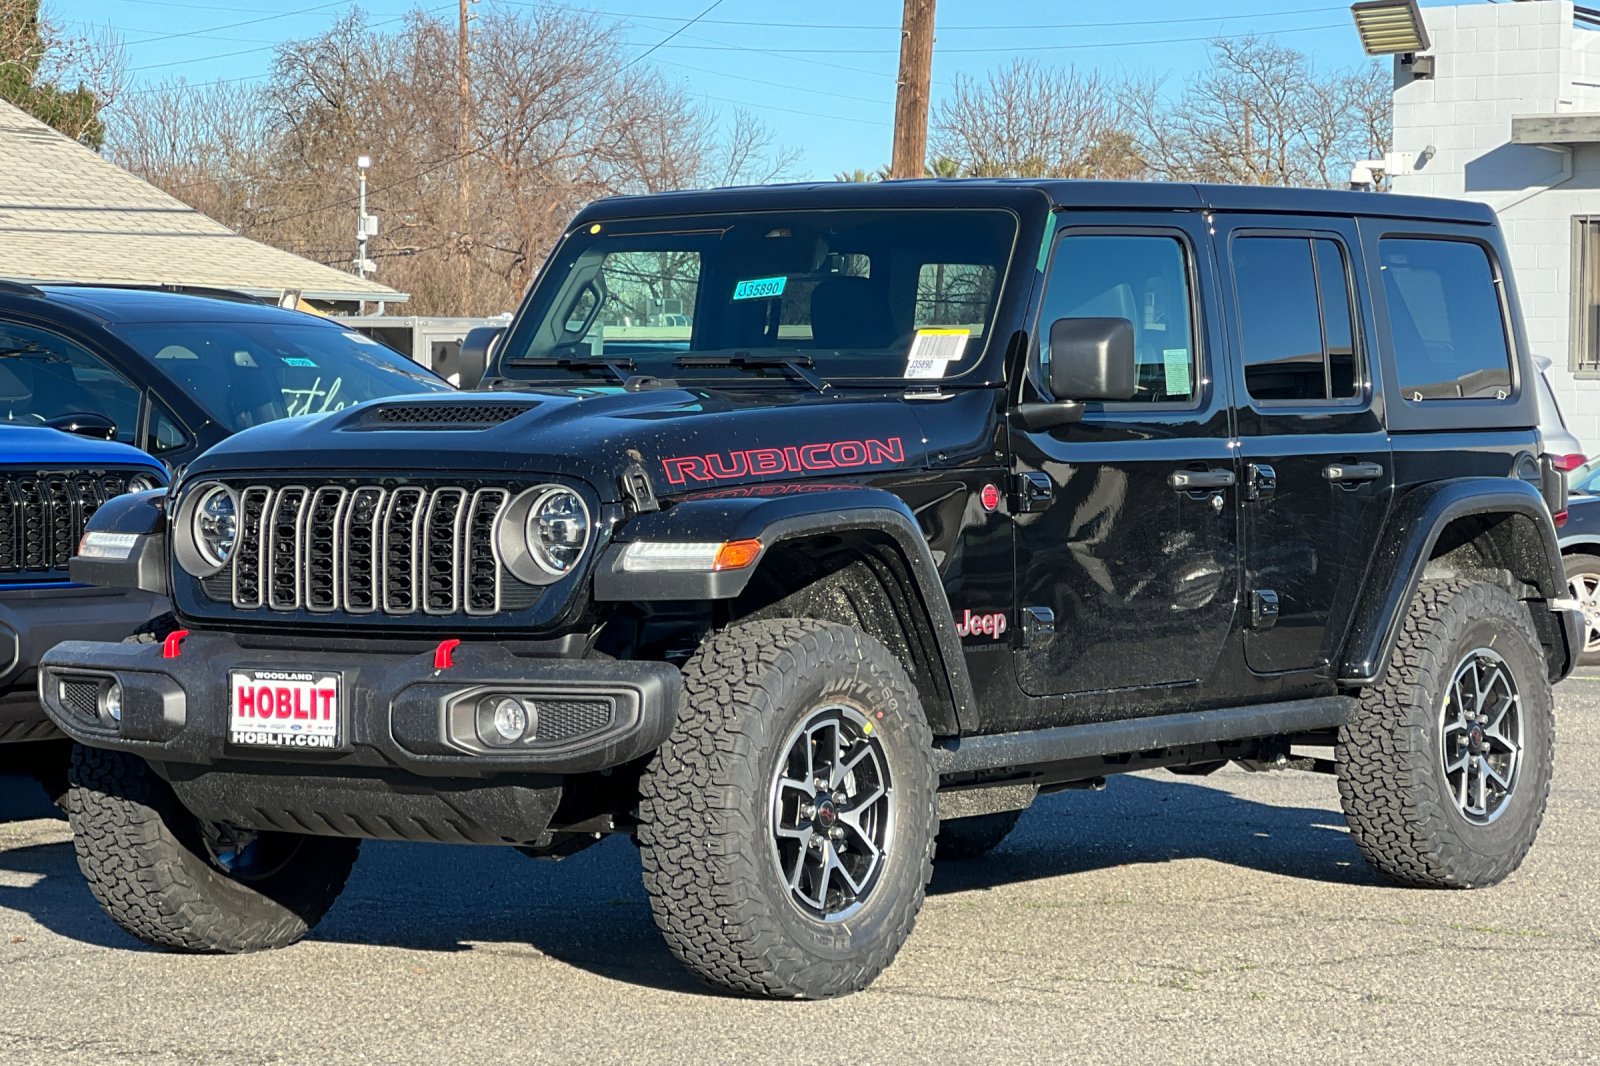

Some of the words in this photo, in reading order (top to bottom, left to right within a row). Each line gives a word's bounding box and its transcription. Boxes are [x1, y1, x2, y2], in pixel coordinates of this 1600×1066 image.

[738, 282, 780, 297] J35890
[662, 437, 905, 485] RUBICON
[956, 609, 1007, 639] Jeep
[255, 671, 313, 681] WOODLAND
[238, 686, 335, 720] HOBLIT
[233, 731, 333, 747] HOBLIT.COM
